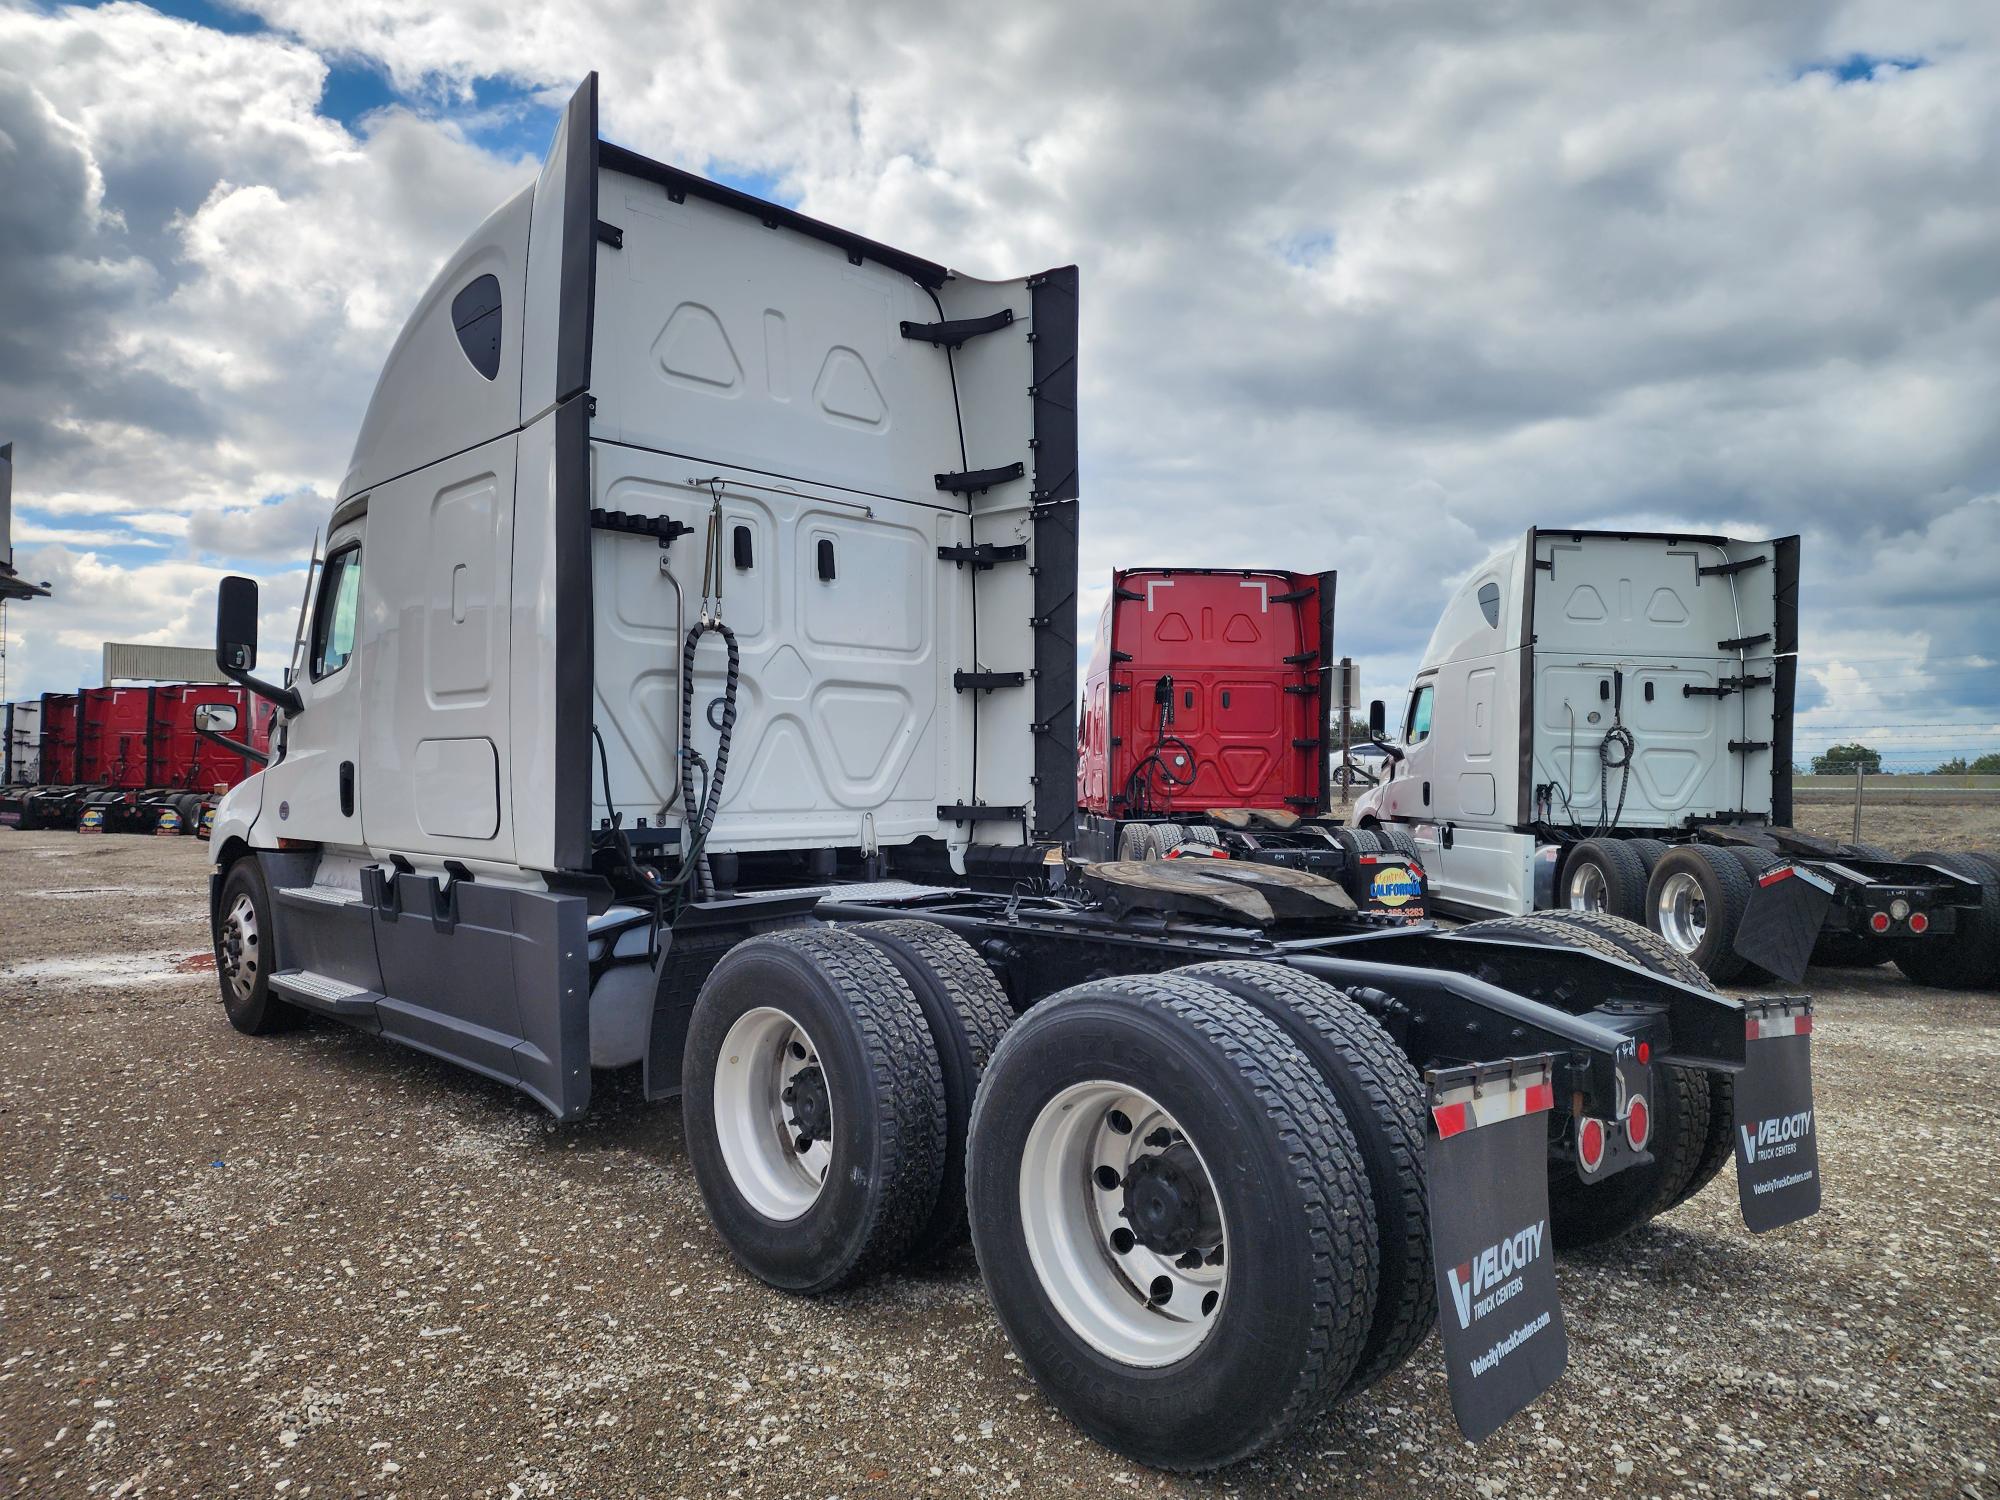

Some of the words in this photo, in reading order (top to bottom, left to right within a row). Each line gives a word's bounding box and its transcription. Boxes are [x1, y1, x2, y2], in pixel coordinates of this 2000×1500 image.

[1370, 881, 1421, 897] CALIFORNIA
[1758, 1110, 1811, 1147] VELOCITY
[1757, 1148, 1775, 1161] TRUCK
[1774, 1143, 1797, 1157] CENTERS
[1753, 1170, 1813, 1195] VelocityTruckCenters.com
[1473, 1220, 1545, 1297] VELOCITY
[1473, 1292, 1496, 1321] TRUCK
[1495, 1276, 1523, 1307] CENTERS
[1470, 1311, 1551, 1378] VelocityTruckCenters.com
